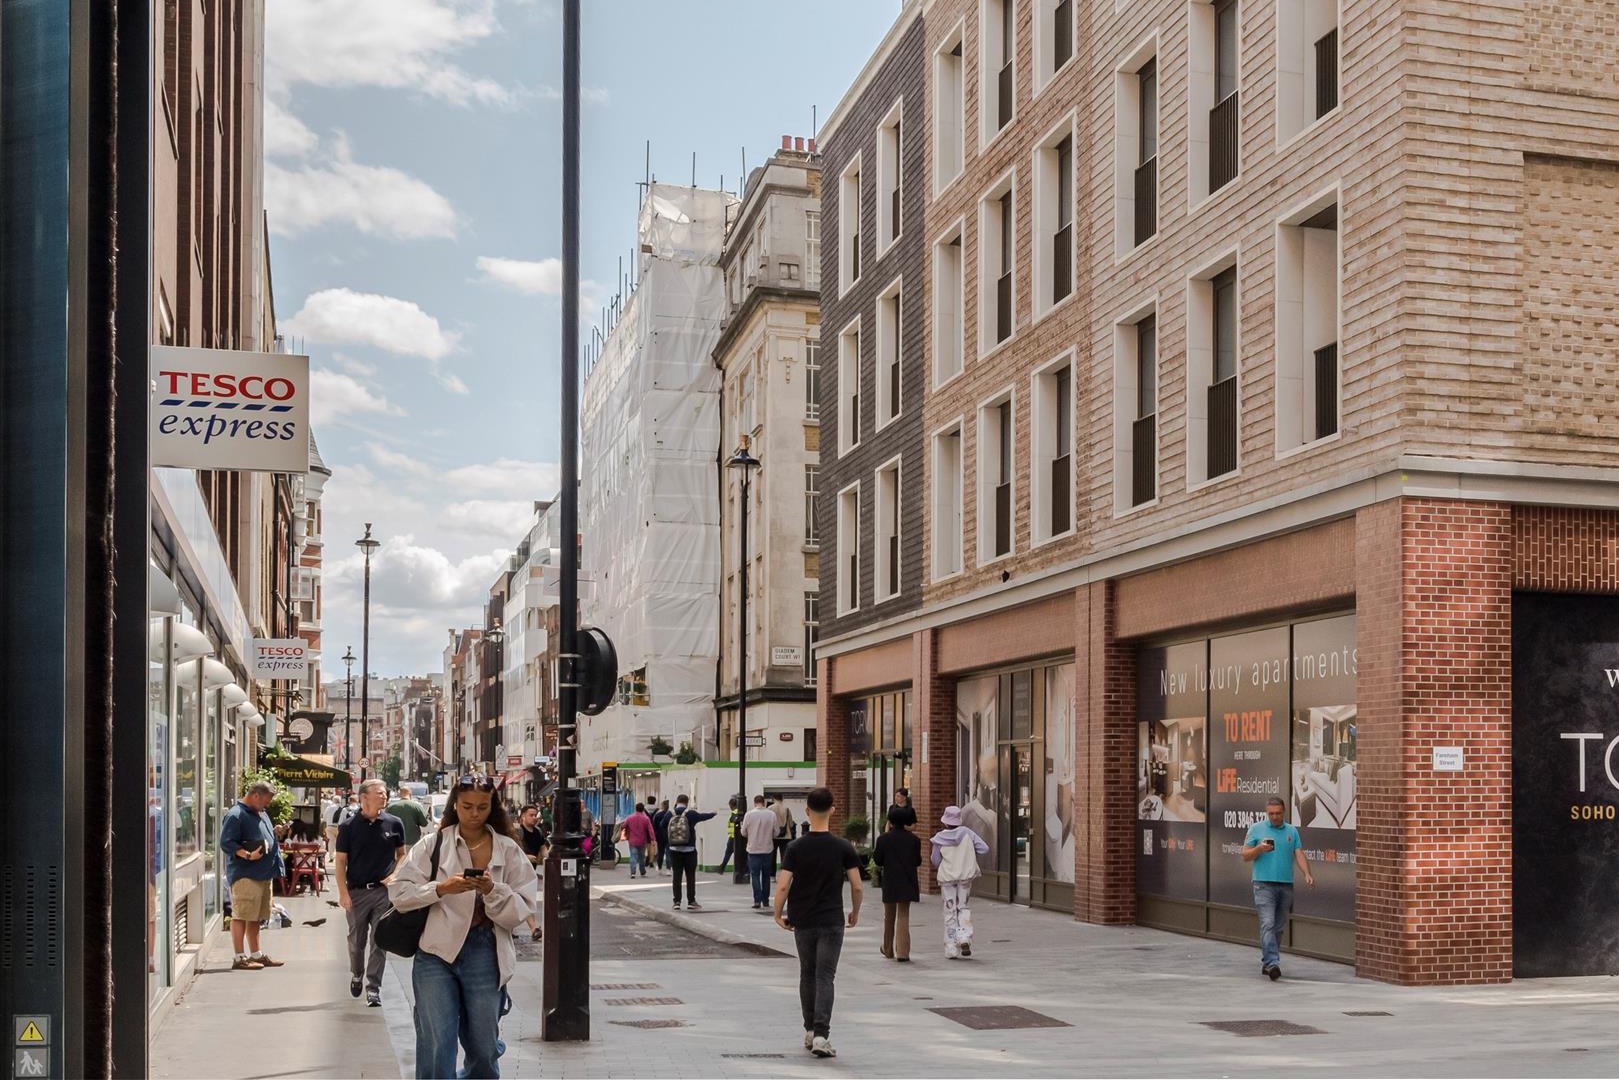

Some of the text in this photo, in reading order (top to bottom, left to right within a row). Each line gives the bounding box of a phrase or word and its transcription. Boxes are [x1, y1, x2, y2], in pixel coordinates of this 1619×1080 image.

[159, 371, 296, 401] TESCO
[159, 414, 296, 445] express
[257, 646, 304, 656] TESCO
[257, 660, 304, 671] express
[1160, 645, 1358, 696] New luxury apartments
[1223, 710, 1272, 744] TO RENT
[1237, 777, 1280, 794] Residential
[1224, 810, 1237, 828] 020
[1237, 810, 1254, 829] 3846
[1570, 805, 1616, 820] SOHO
